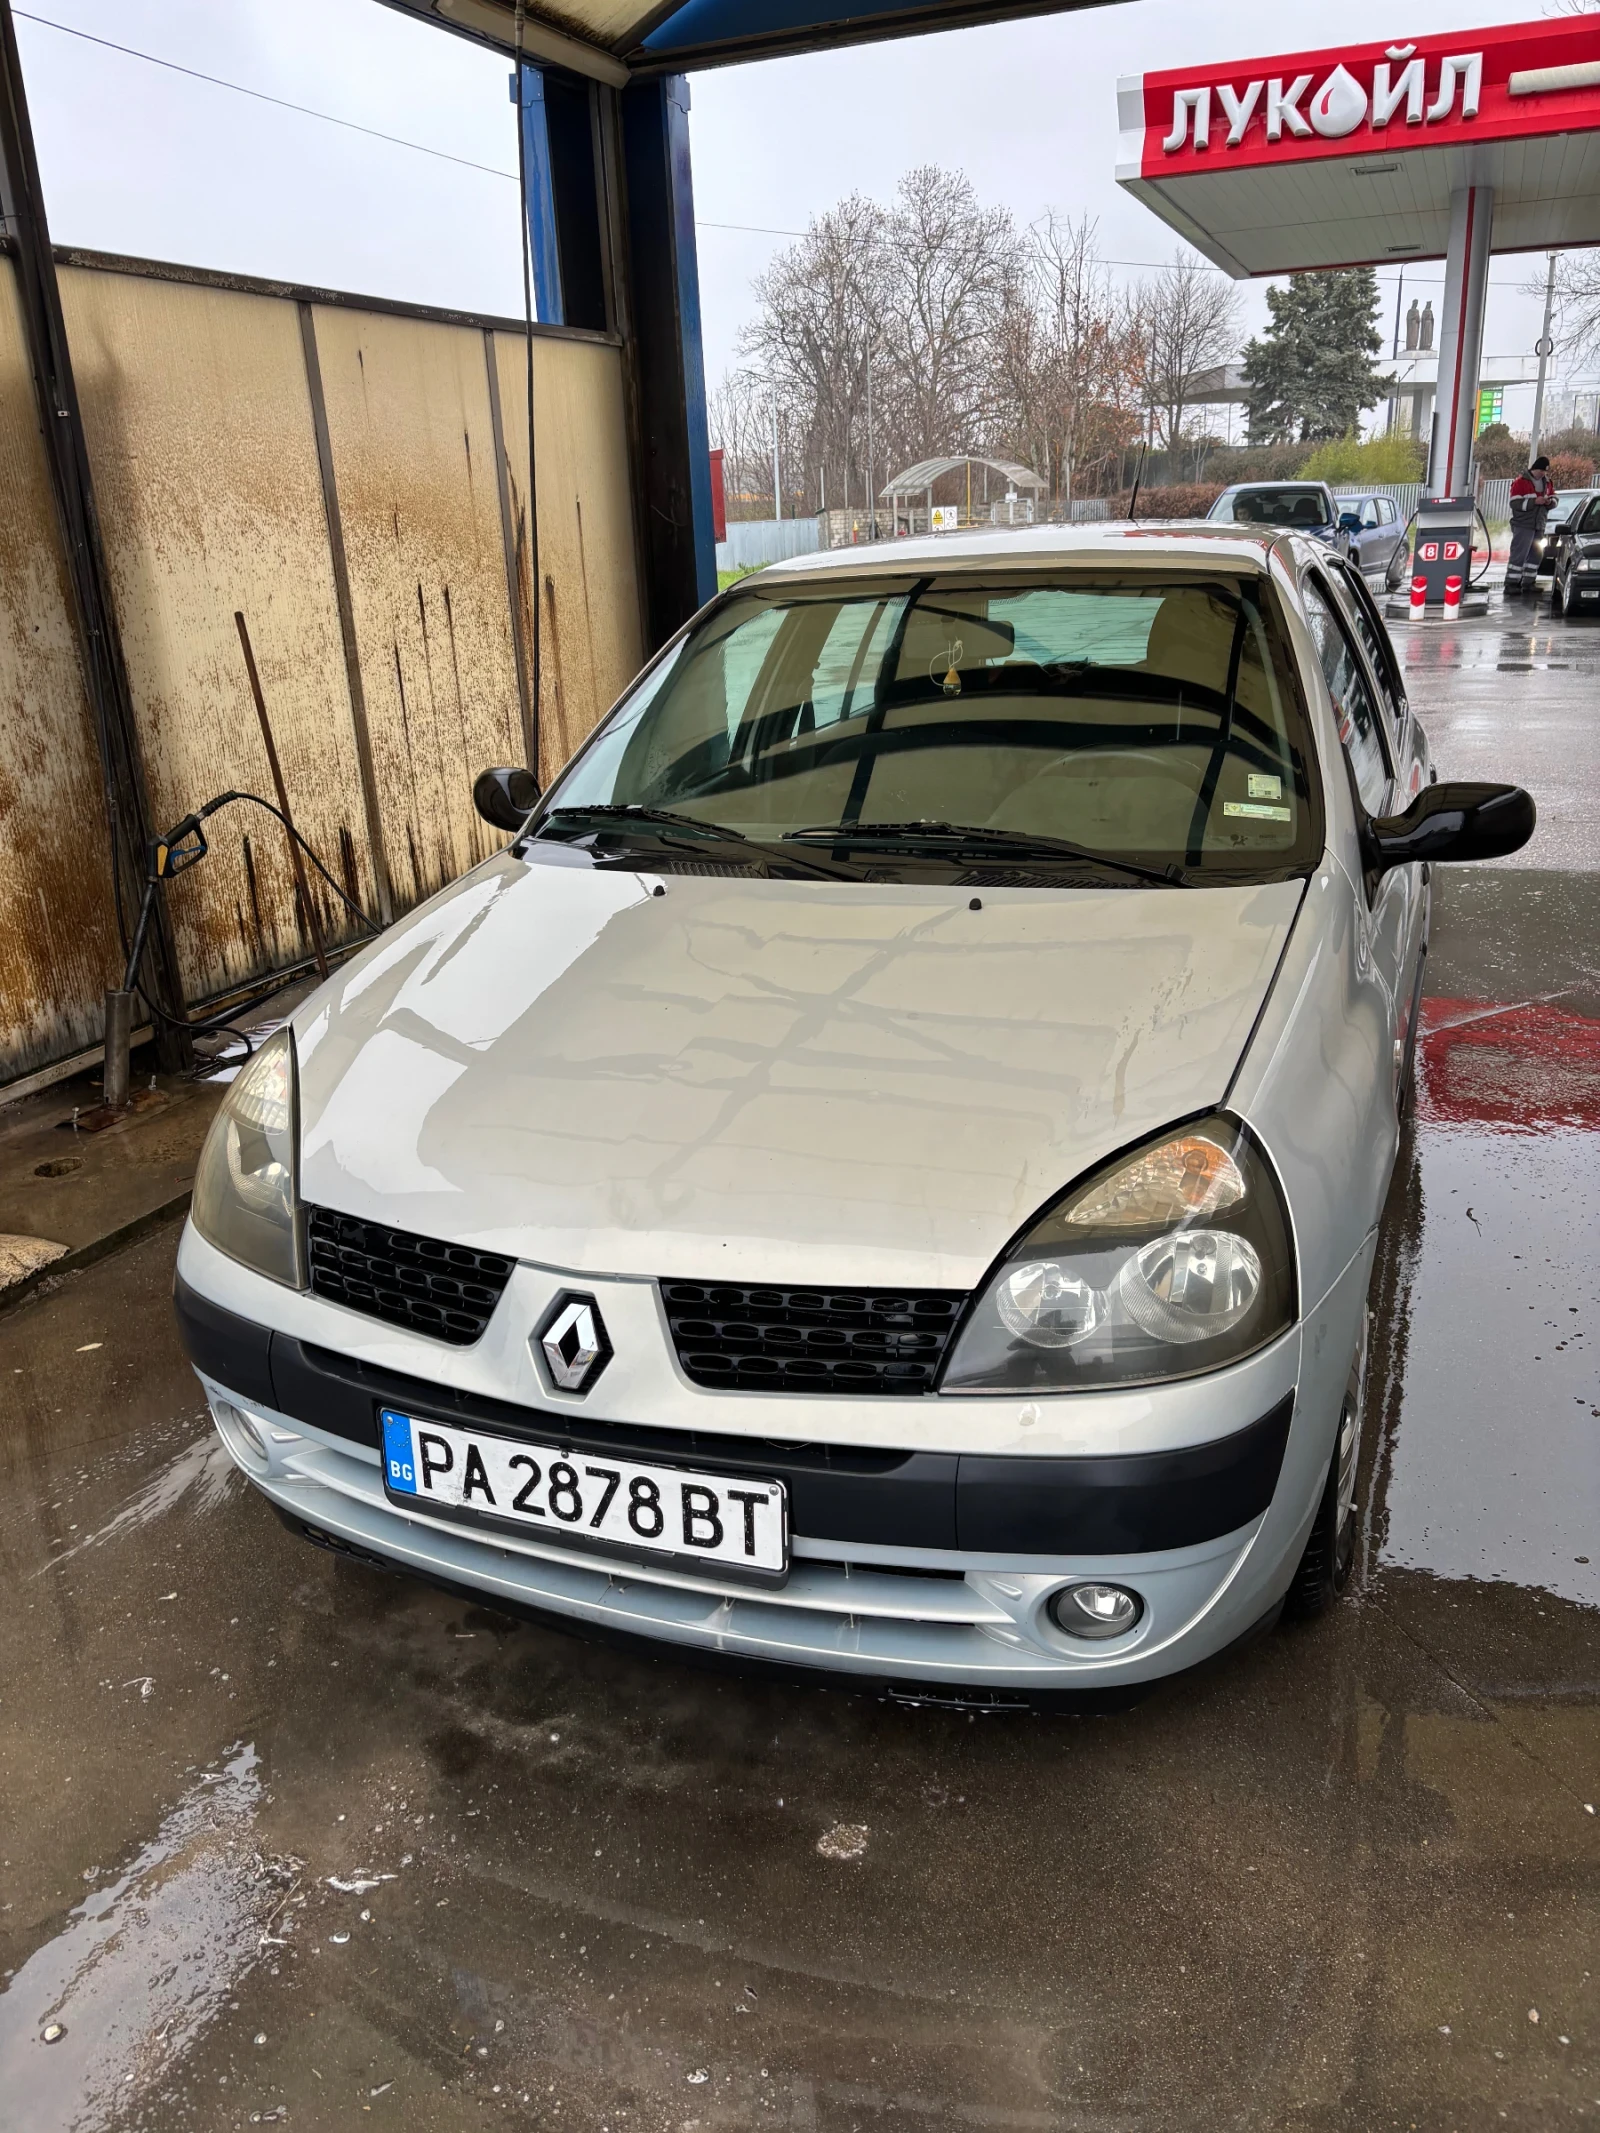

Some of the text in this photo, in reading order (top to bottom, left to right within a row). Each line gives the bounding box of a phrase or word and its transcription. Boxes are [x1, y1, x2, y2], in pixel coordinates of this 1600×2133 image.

[1427, 546, 1435, 557] 8
[1447, 546, 1455, 556] 7
[390, 1459, 413, 1481] BG
[418, 1430, 770, 1556] PA 2878 BT
